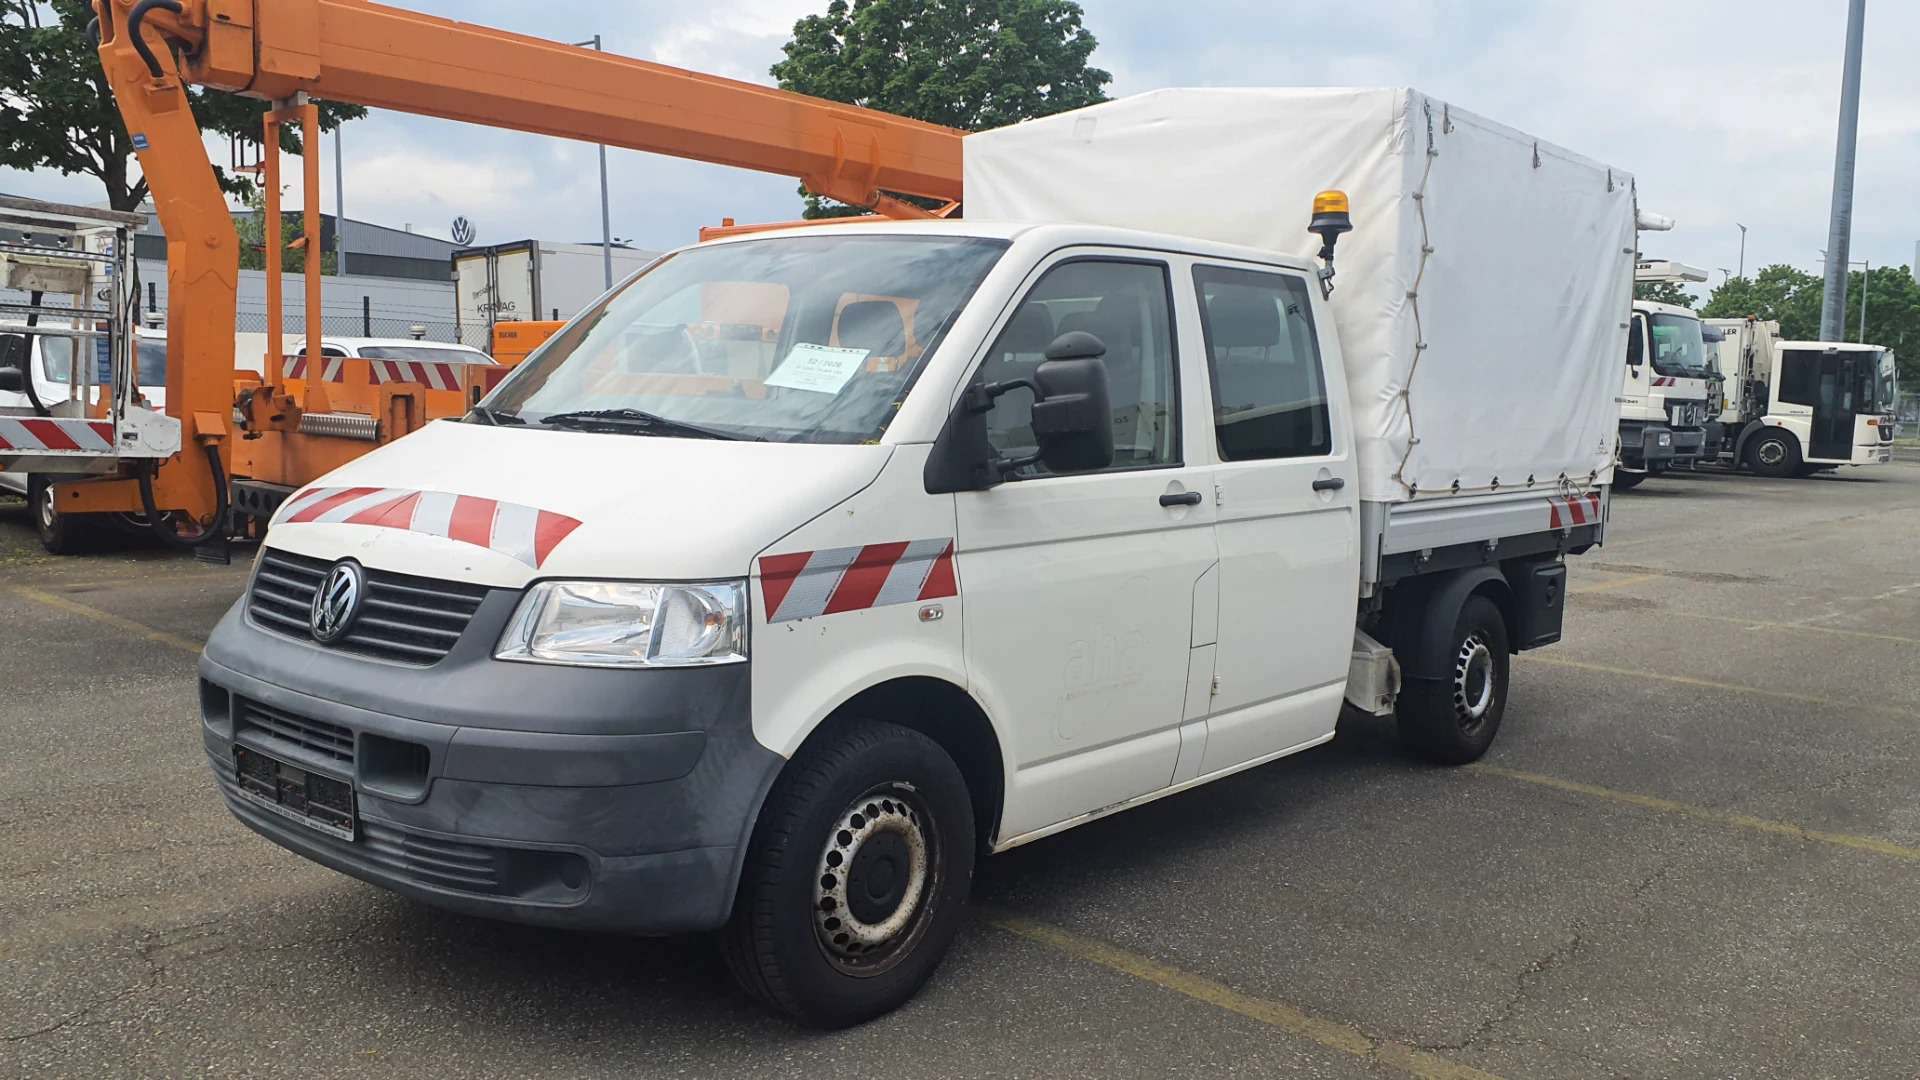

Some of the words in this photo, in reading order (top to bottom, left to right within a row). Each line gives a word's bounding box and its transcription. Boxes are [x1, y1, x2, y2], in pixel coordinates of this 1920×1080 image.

[452, 216, 471, 244] VW
[1723, 328, 1737, 336] LER
[315, 564, 358, 636] VW
